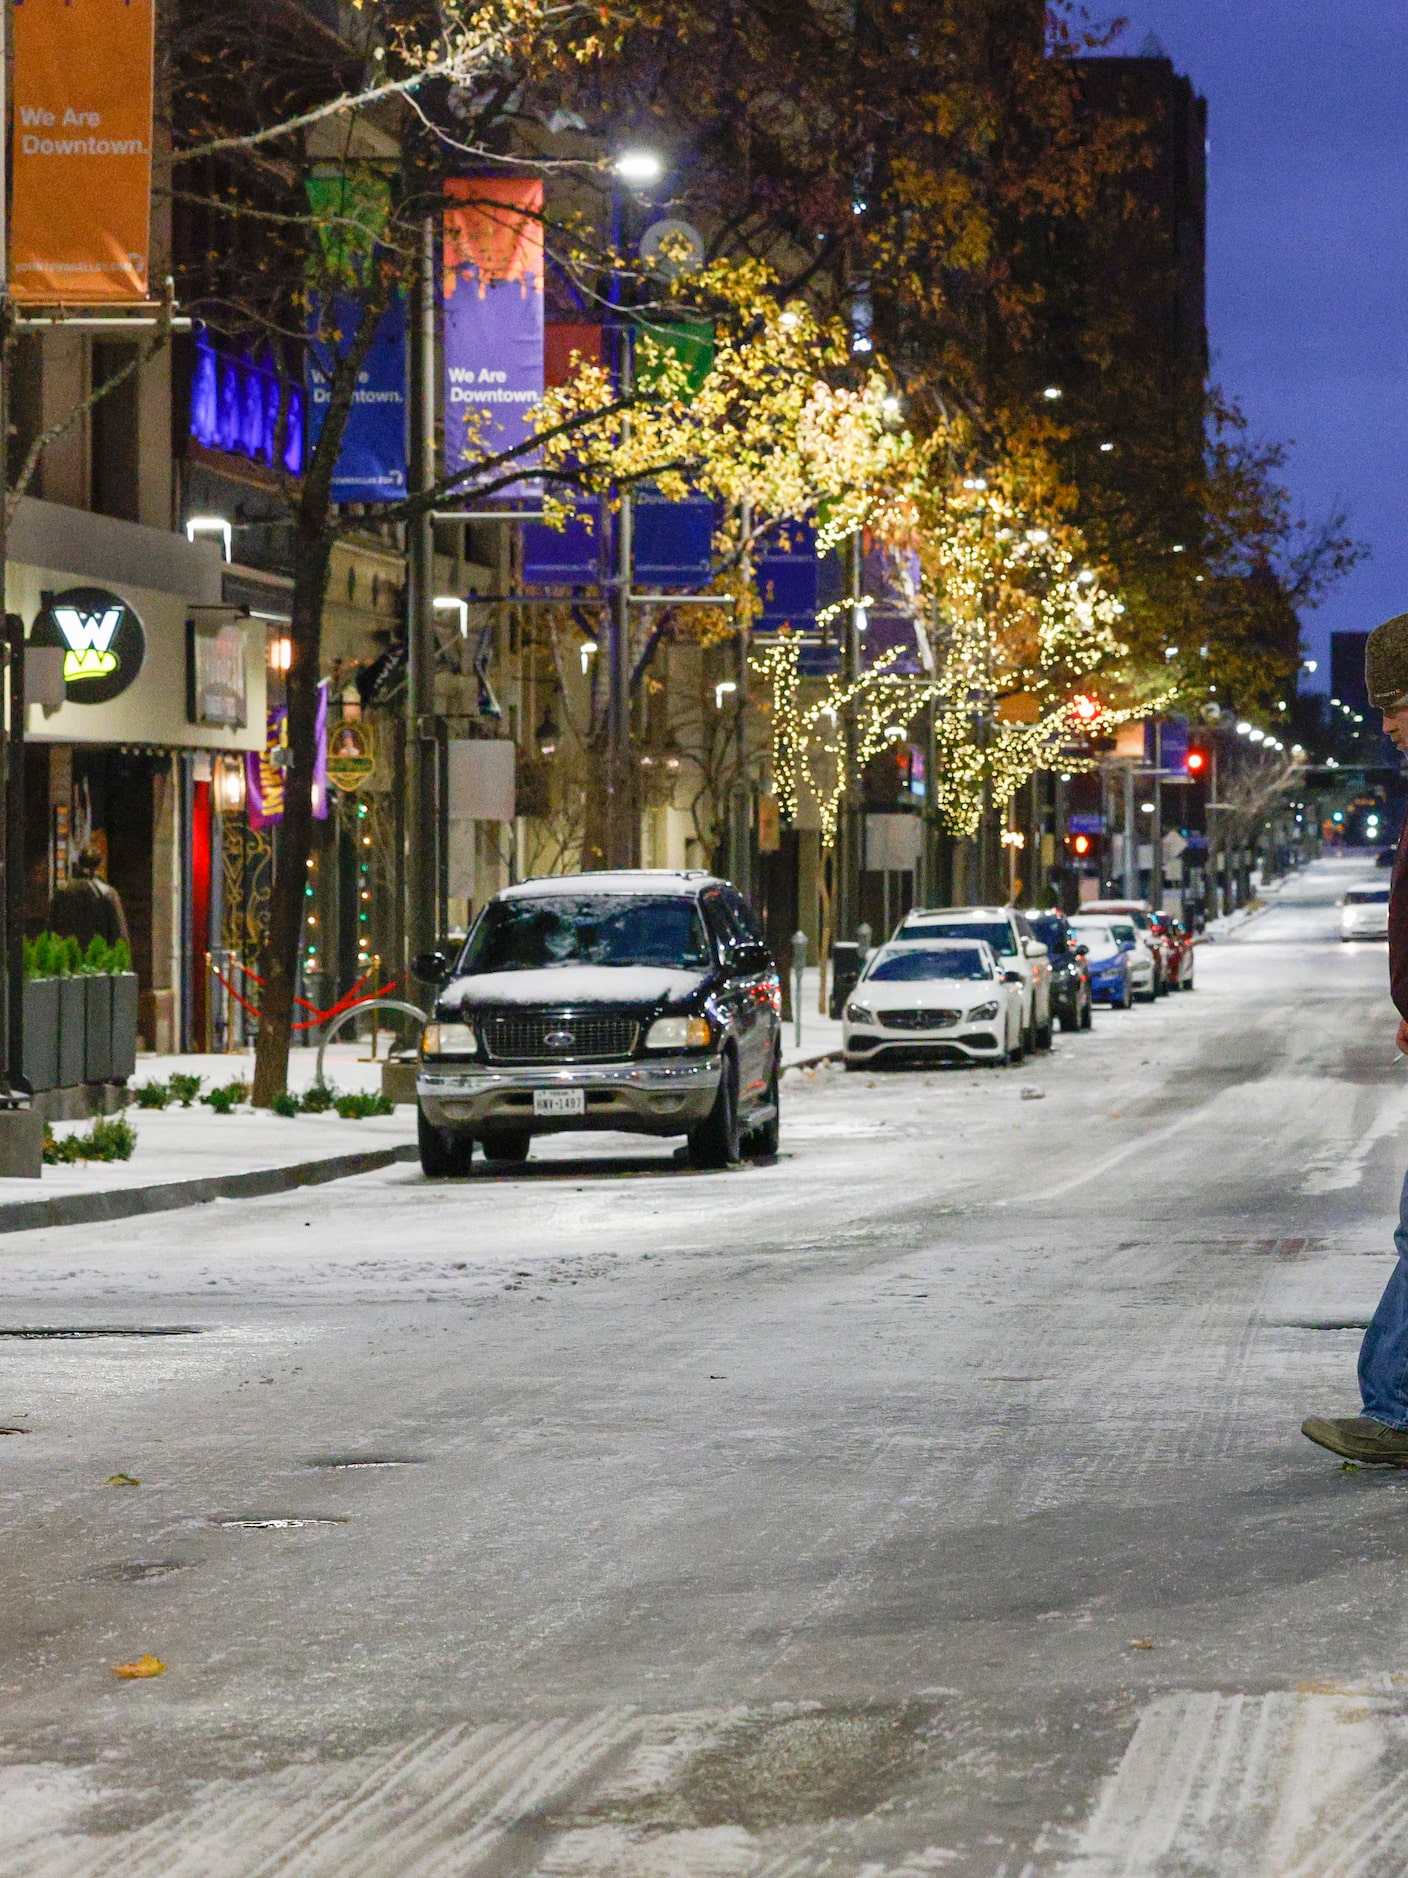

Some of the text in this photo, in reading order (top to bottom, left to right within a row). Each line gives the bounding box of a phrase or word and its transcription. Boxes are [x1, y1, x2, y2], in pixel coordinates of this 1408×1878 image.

[19, 107, 101, 127] We Are
[21, 134, 150, 155] Downtown.
[448, 368, 506, 384] We Are
[450, 388, 542, 404] Downtown.
